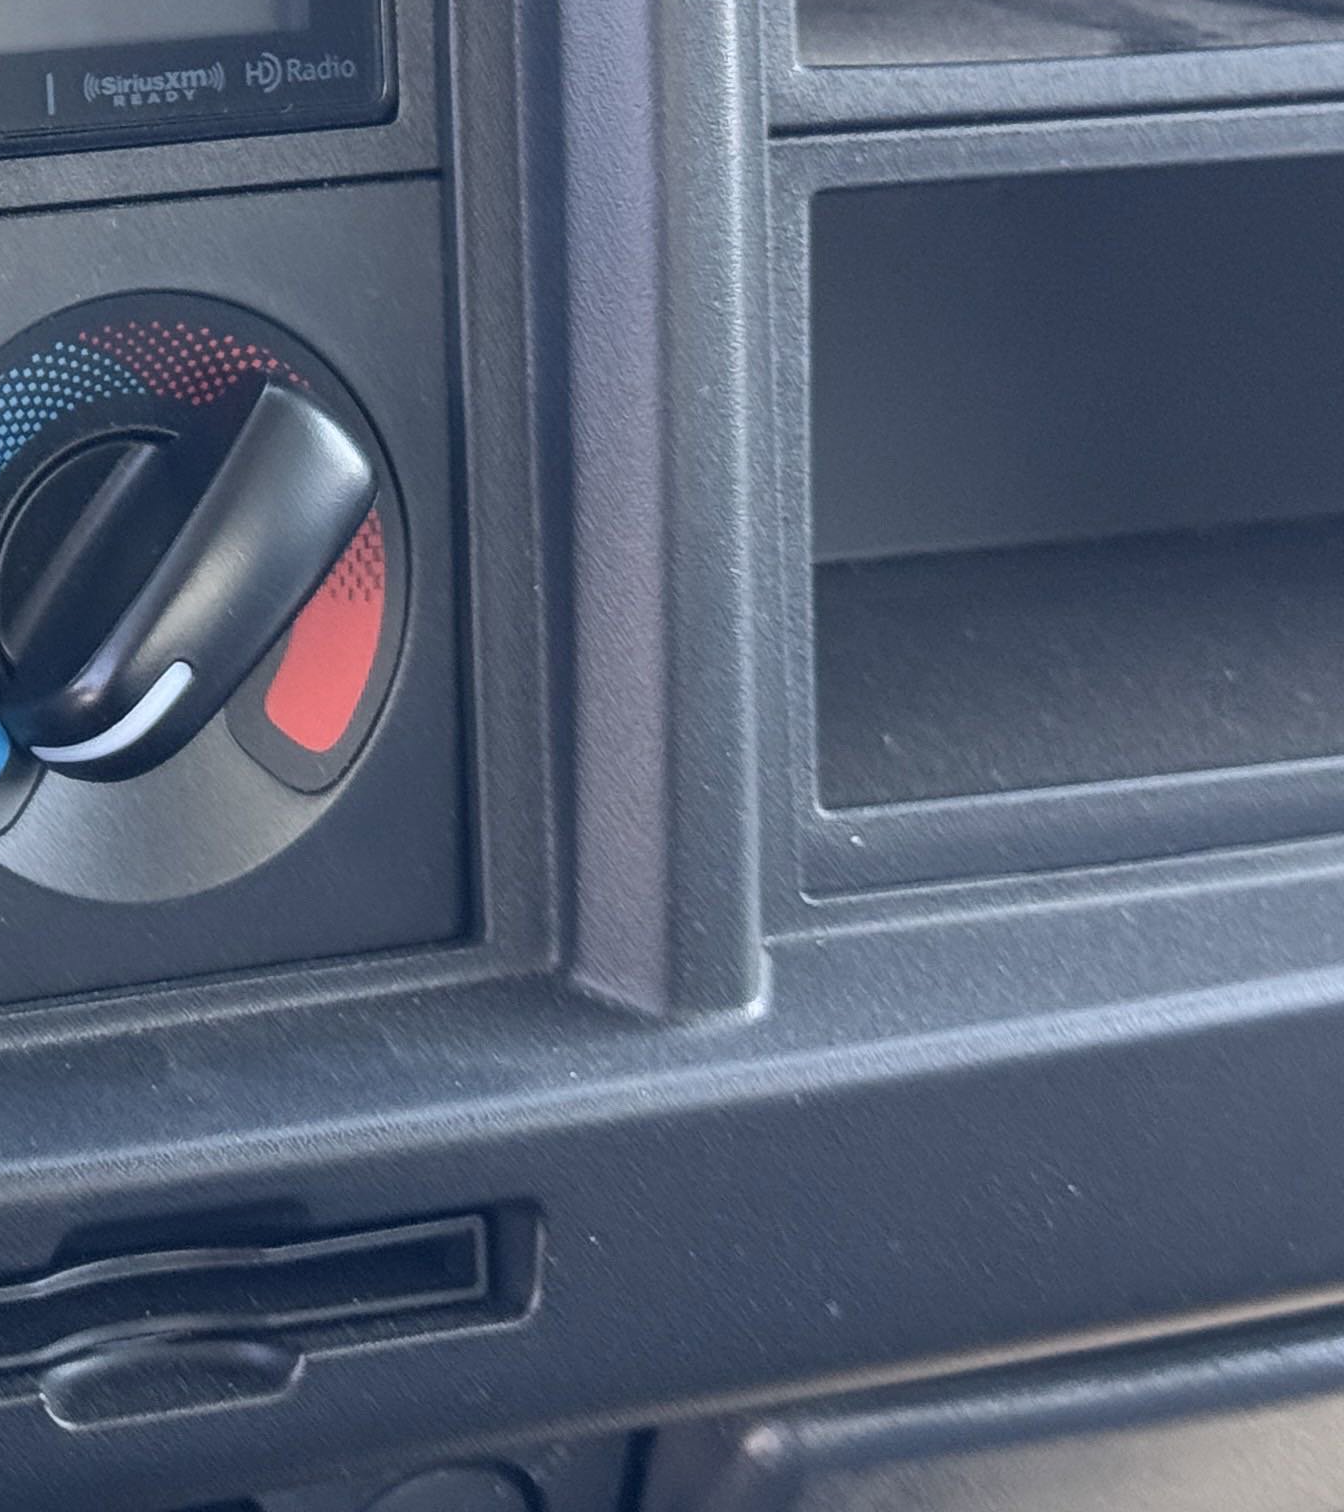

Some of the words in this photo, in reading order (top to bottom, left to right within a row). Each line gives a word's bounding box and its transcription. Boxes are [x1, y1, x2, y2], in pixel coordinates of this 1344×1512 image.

[245, 52, 282, 93] HD
[286, 53, 355, 83] Radio
[112, 88, 196, 107] READY
